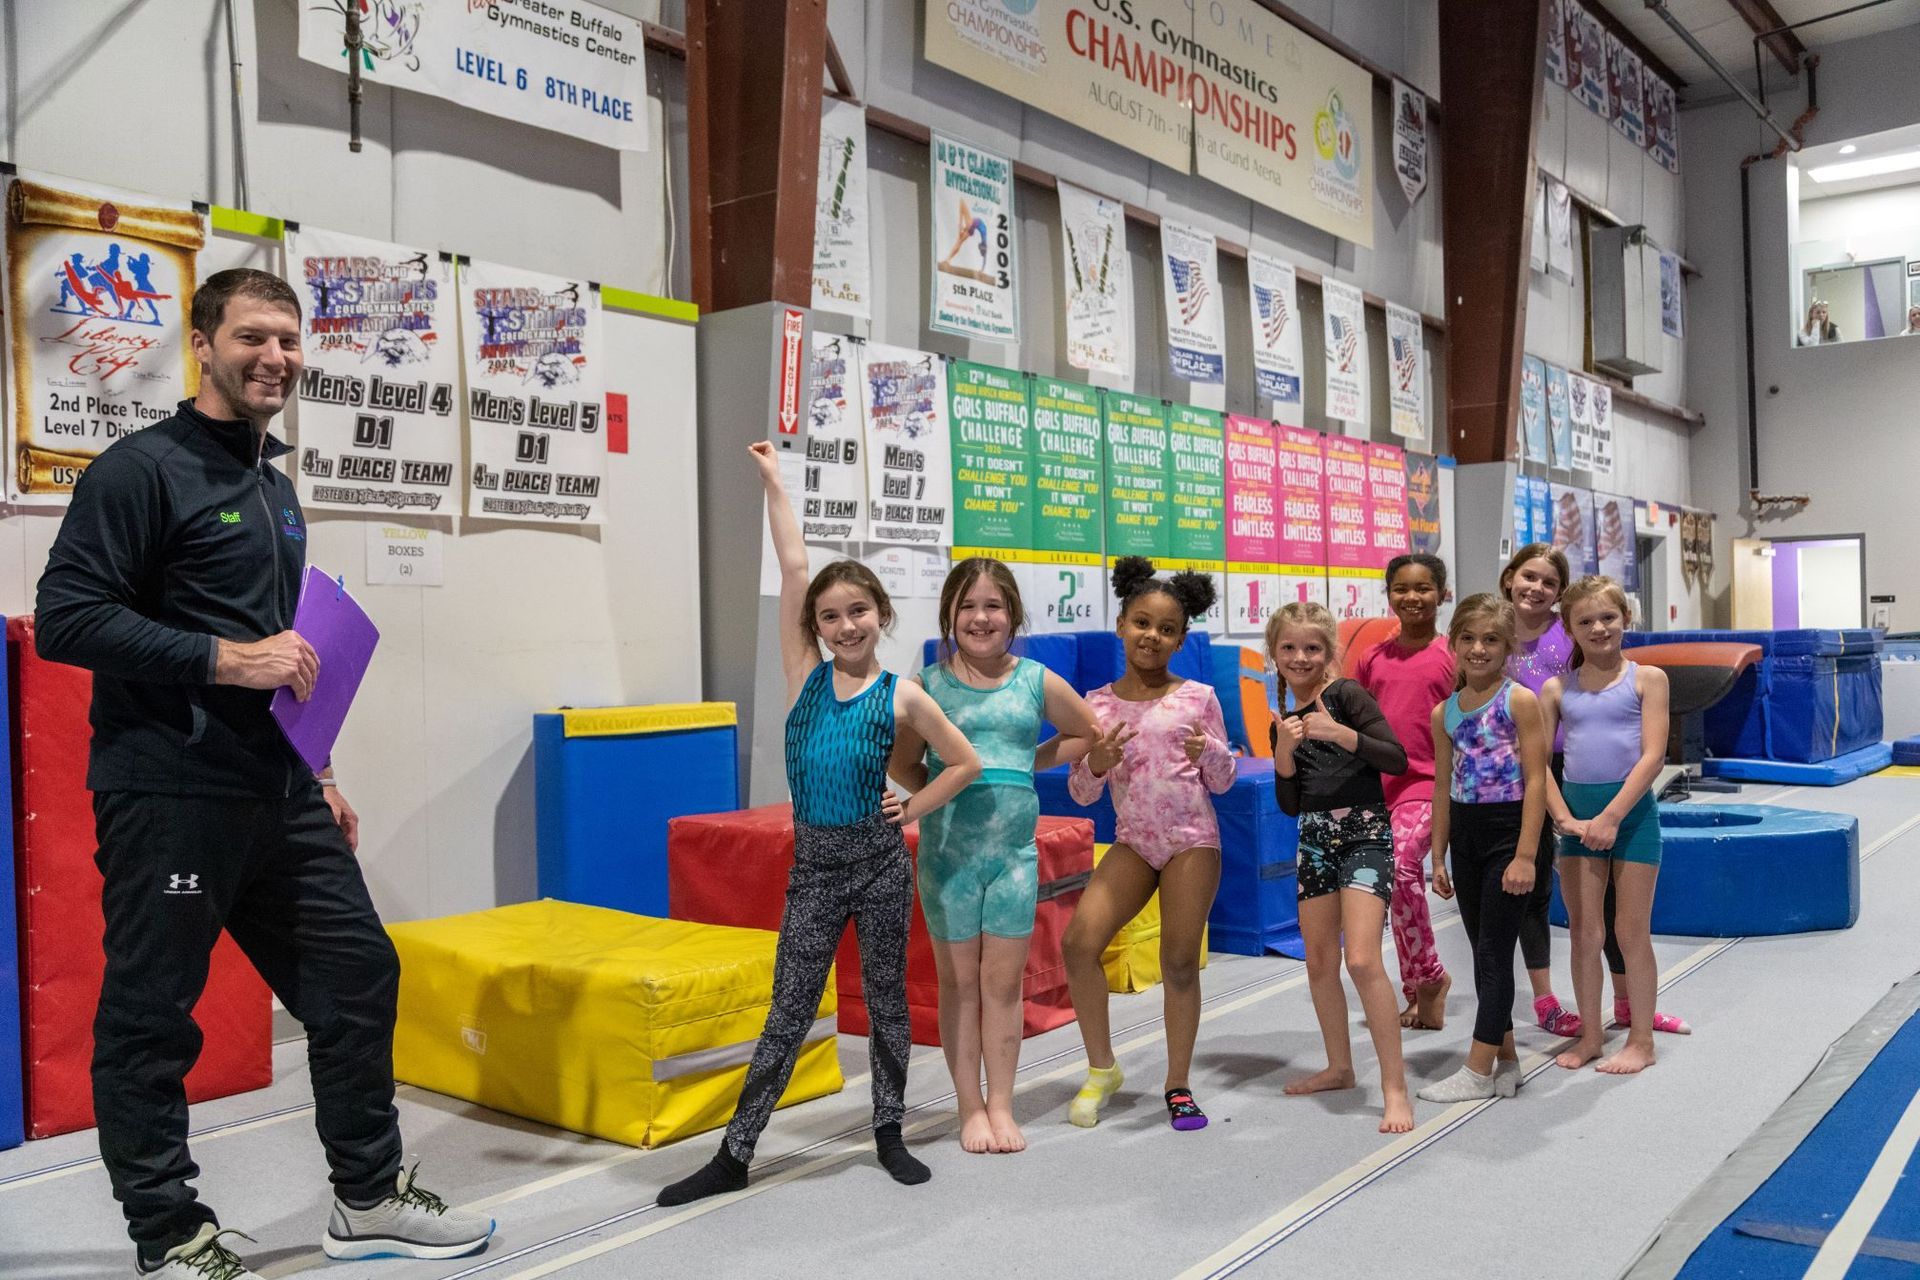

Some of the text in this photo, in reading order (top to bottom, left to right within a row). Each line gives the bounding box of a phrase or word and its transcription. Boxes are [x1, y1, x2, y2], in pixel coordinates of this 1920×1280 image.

[503, 0, 565, 21] reater
[570, 11, 622, 42] Buffalo
[487, 5, 636, 66] Gymnastics Center
[947, 2, 1047, 63] CHAMPIONSHIPS
[1151, 18, 1278, 104] Gymnastics
[456, 47, 634, 122] LEVEL 6 8TH PLACE
[1065, 8, 1297, 161] CHAMPIONSHIPS
[1088, 81, 1144, 123] AUGUST
[1147, 108, 1166, 135] 7th
[1207, 140, 1217, 157] at
[1219, 143, 1250, 172] Gund
[1252, 158, 1282, 187] Arena
[967, 150, 1007, 185] CLASSIC
[945, 168, 1001, 206] INVITATIONAL
[996, 213, 1010, 290] 2003
[303, 256, 408, 279] STARS AND
[343, 279, 438, 304] STRIPES
[474, 288, 564, 310] STARS AND
[822, 288, 861, 303] PLACE
[953, 283, 994, 304] 5th PLACE
[335, 302, 435, 315] COED GYMNASTICS
[311, 315, 432, 334] INVITATIONAL
[508, 308, 586, 331] STRIPES
[786, 319, 801, 333] FIRE
[40, 316, 159, 355] Liberty
[320, 334, 352, 346] 2020
[480, 339, 582, 359] INVITATIONAL
[69, 343, 139, 381] Cup
[488, 358, 516, 369] 2020
[1181, 360, 1214, 373] PLACE
[786, 335, 796, 422] EXTINGUISHER
[886, 375, 937, 397] STRIPES
[986, 373, 1010, 389] ANNUAL
[1264, 380, 1291, 393] PLACE
[299, 366, 453, 416] Men's Level 4
[50, 392, 171, 421] 2nd Place Team
[471, 388, 601, 433] Men's Level 5
[953, 394, 982, 420] GIRLS
[985, 400, 1028, 429] BUFFALO
[44, 415, 99, 437] Level 7
[353, 413, 394, 449] D1
[960, 420, 1023, 449] CHALLENGE
[1034, 408, 1061, 432] GIRLS
[1062, 412, 1100, 441] BUFFALO
[1040, 431, 1096, 459] CHALLENGE
[1108, 422, 1129, 445] GIRLS
[1131, 427, 1166, 451] BUFFALO
[1171, 432, 1192, 453] GIRLS
[1193, 436, 1224, 460] BUFFALO
[515, 431, 550, 464] D1
[805, 434, 858, 465] Level 6
[884, 443, 925, 473] Men's
[984, 443, 1002, 455] 2020
[1113, 444, 1162, 469] CHALLENGE
[1228, 441, 1246, 462] GIRLS
[1247, 445, 1276, 468] BUFFALO
[301, 447, 453, 486] 4TH PLACE TEAM
[976, 456, 985, 468] IT
[988, 457, 1025, 473] DOESN'T
[1055, 466, 1096, 481] IT DOESN'T
[1176, 453, 1220, 477] CHALLENGE
[1233, 461, 1273, 484] CHALLENGE
[1279, 450, 1297, 469] GIRLS
[1297, 453, 1323, 476] BUFFALO
[1342, 461, 1366, 482] BUFFALO
[473, 463, 601, 497] 4TH PLACE TEAM
[882, 472, 926, 500] Level 7
[958, 468, 1028, 487] CHALLENGE YOU
[1037, 476, 1100, 495] CHALLENGE YOU
[1124, 477, 1162, 490] IT DOESN'T
[1283, 469, 1320, 490] CHALLENGE
[1329, 476, 1363, 496] CHALLENGE
[1383, 468, 1405, 487] BUFFALO
[313, 485, 343, 501] HOSTED
[344, 487, 358, 503] BY
[974, 484, 1012, 499] IT WON'T
[1051, 492, 1085, 506] IT WON'T
[1112, 487, 1166, 502] CHALLENGE YOU
[1195, 483, 1221, 496] DOESN'T
[1372, 482, 1402, 502] CHALLENGE
[824, 499, 858, 519] TEAM
[964, 498, 998, 512] CHANGE
[1123, 501, 1153, 514] IT WON'T
[1174, 493, 1224, 508] CHALLENGE YOU
[1233, 494, 1273, 515] FEARLESS
[1283, 500, 1320, 521] FEARLESS
[220, 511, 242, 523] Staff
[885, 503, 946, 525] PLACE TEAM
[1042, 505, 1072, 518] CHANGE
[1116, 513, 1142, 525] CHANGE
[1184, 506, 1213, 518] IT WON'T
[1331, 505, 1364, 524] FEARLESS
[1373, 510, 1404, 529] FEARLESS
[383, 528, 429, 540] YELLOW
[1178, 518, 1203, 529] CHANGE
[1233, 518, 1275, 539] LIMITLESS
[1283, 523, 1322, 542] LIMITLESS
[1330, 527, 1367, 546] LIMITLESS
[388, 545, 425, 557] BOXES
[1050, 553, 1079, 563] LEVEL
[1048, 604, 1091, 618] PLACE
[1240, 606, 1270, 618] PLACE
[1337, 607, 1365, 618] PLACE
